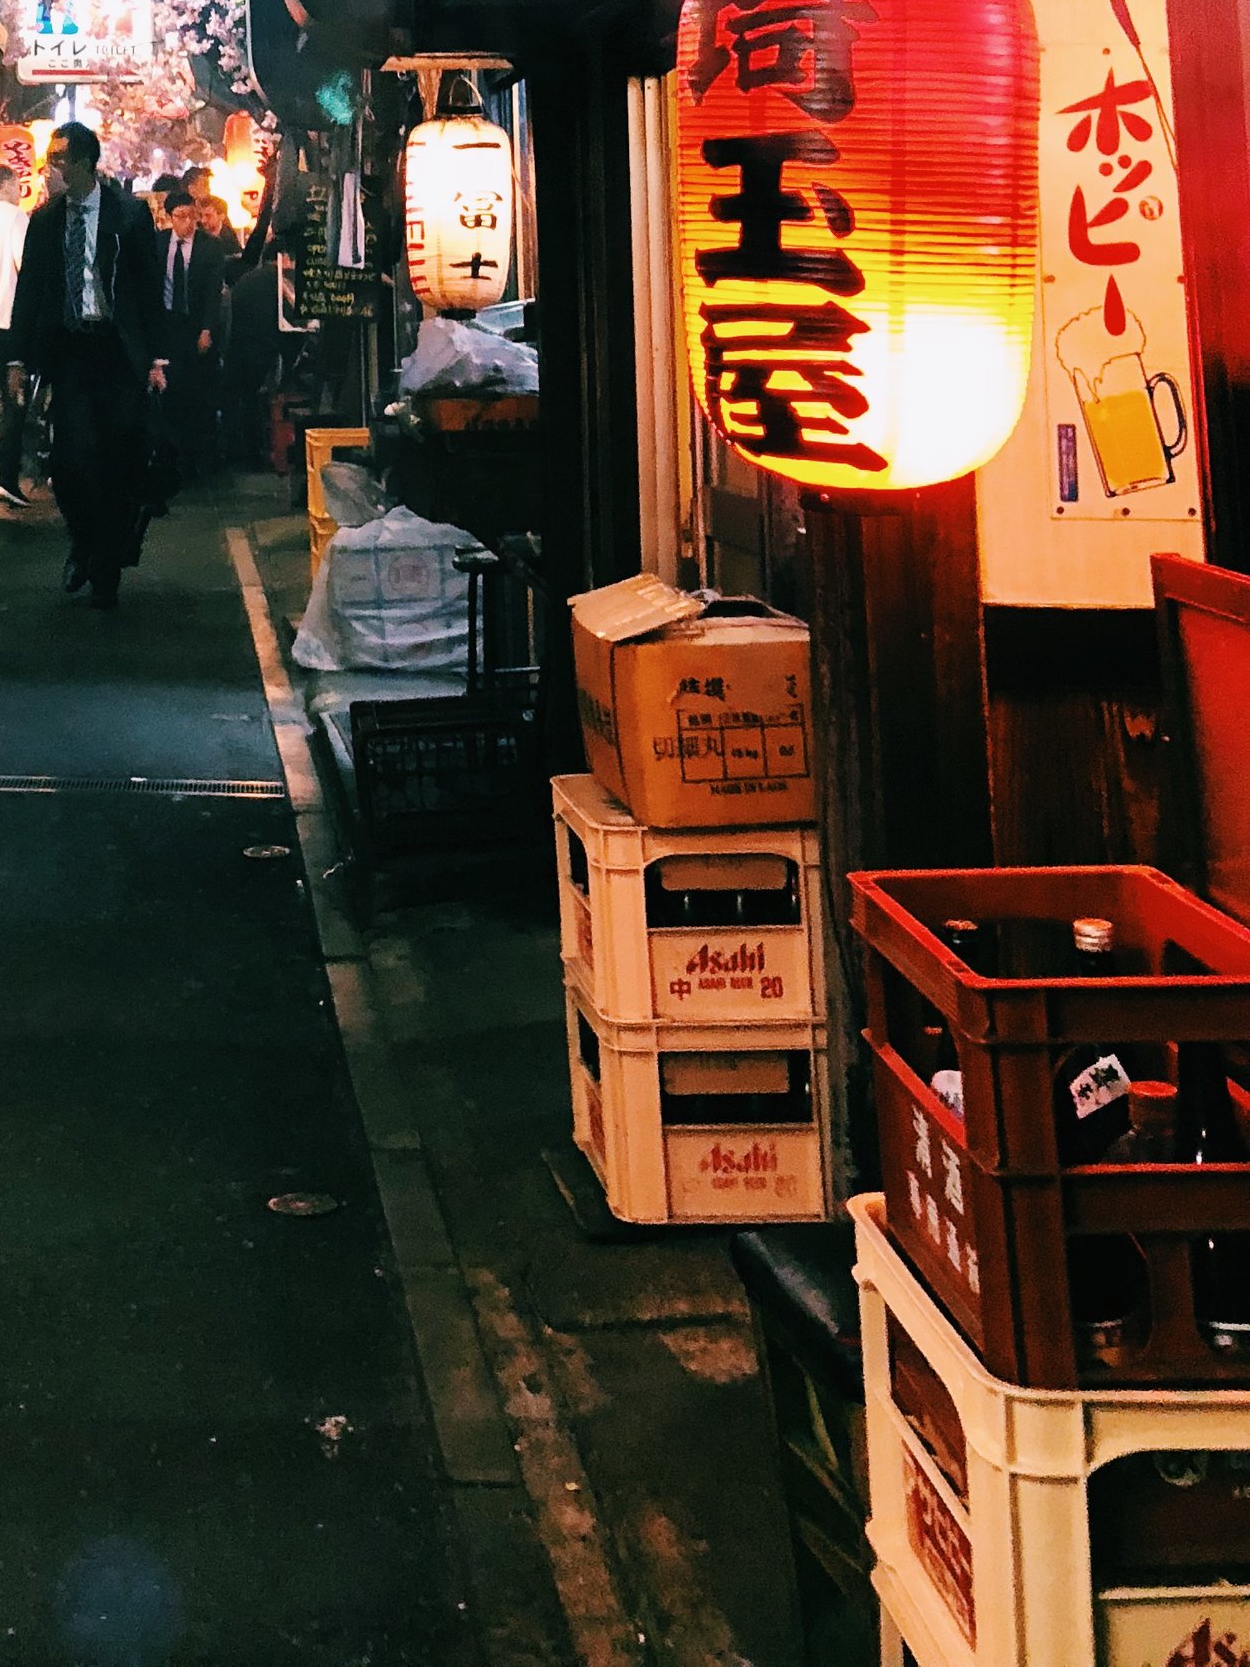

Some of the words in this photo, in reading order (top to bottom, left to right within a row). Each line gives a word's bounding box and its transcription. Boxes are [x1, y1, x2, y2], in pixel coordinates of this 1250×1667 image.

[34, 40, 87, 56] トイレ
[1055, 66, 1154, 336] ホッピー
[686, 942, 765, 974] Asahi
[670, 978, 691, 1001] 中
[760, 976, 784, 999] 20
[699, 1142, 778, 1173] Asahi
